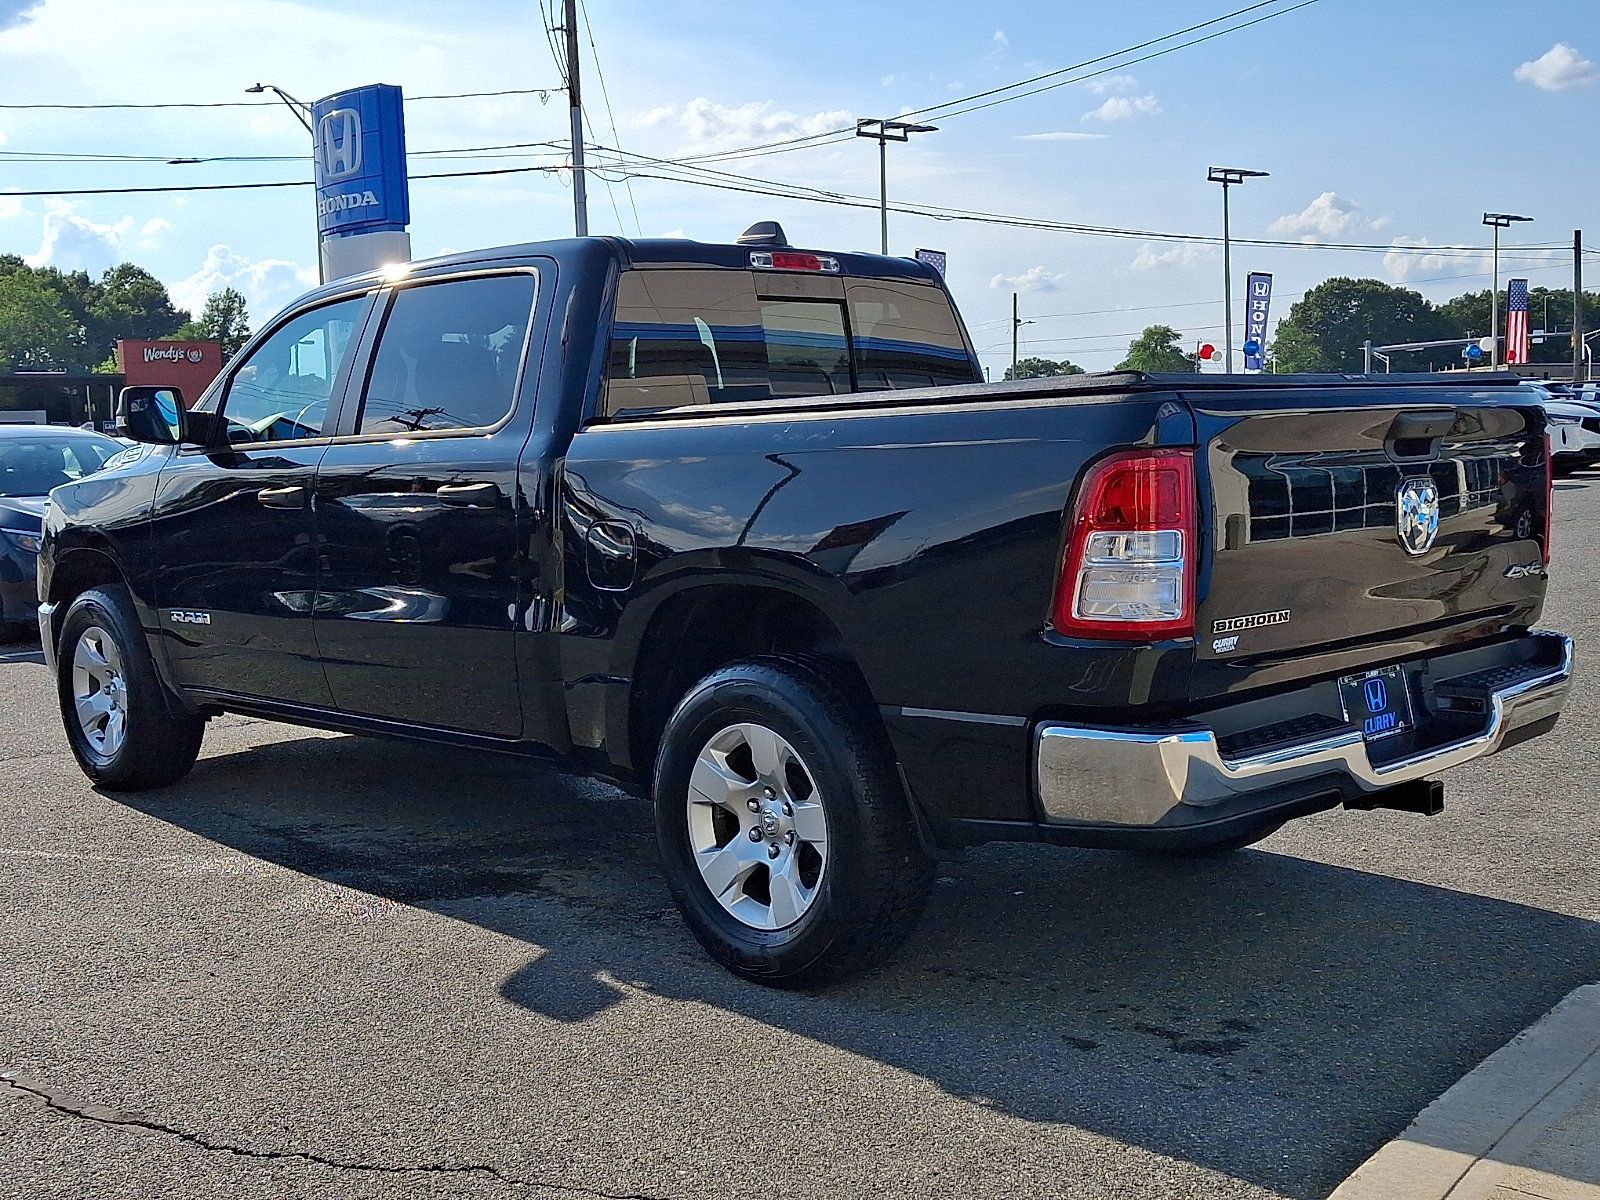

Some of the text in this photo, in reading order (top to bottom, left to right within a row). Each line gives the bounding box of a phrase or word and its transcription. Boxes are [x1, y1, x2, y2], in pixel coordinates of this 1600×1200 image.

[318, 190, 379, 216] HONDA
[143, 346, 185, 363] Wendy's
[170, 610, 211, 625] RAM
[1212, 609, 1291, 634] BIGHORN
[1212, 635, 1240, 650] CURRY
[1364, 712, 1396, 735] CURRY
